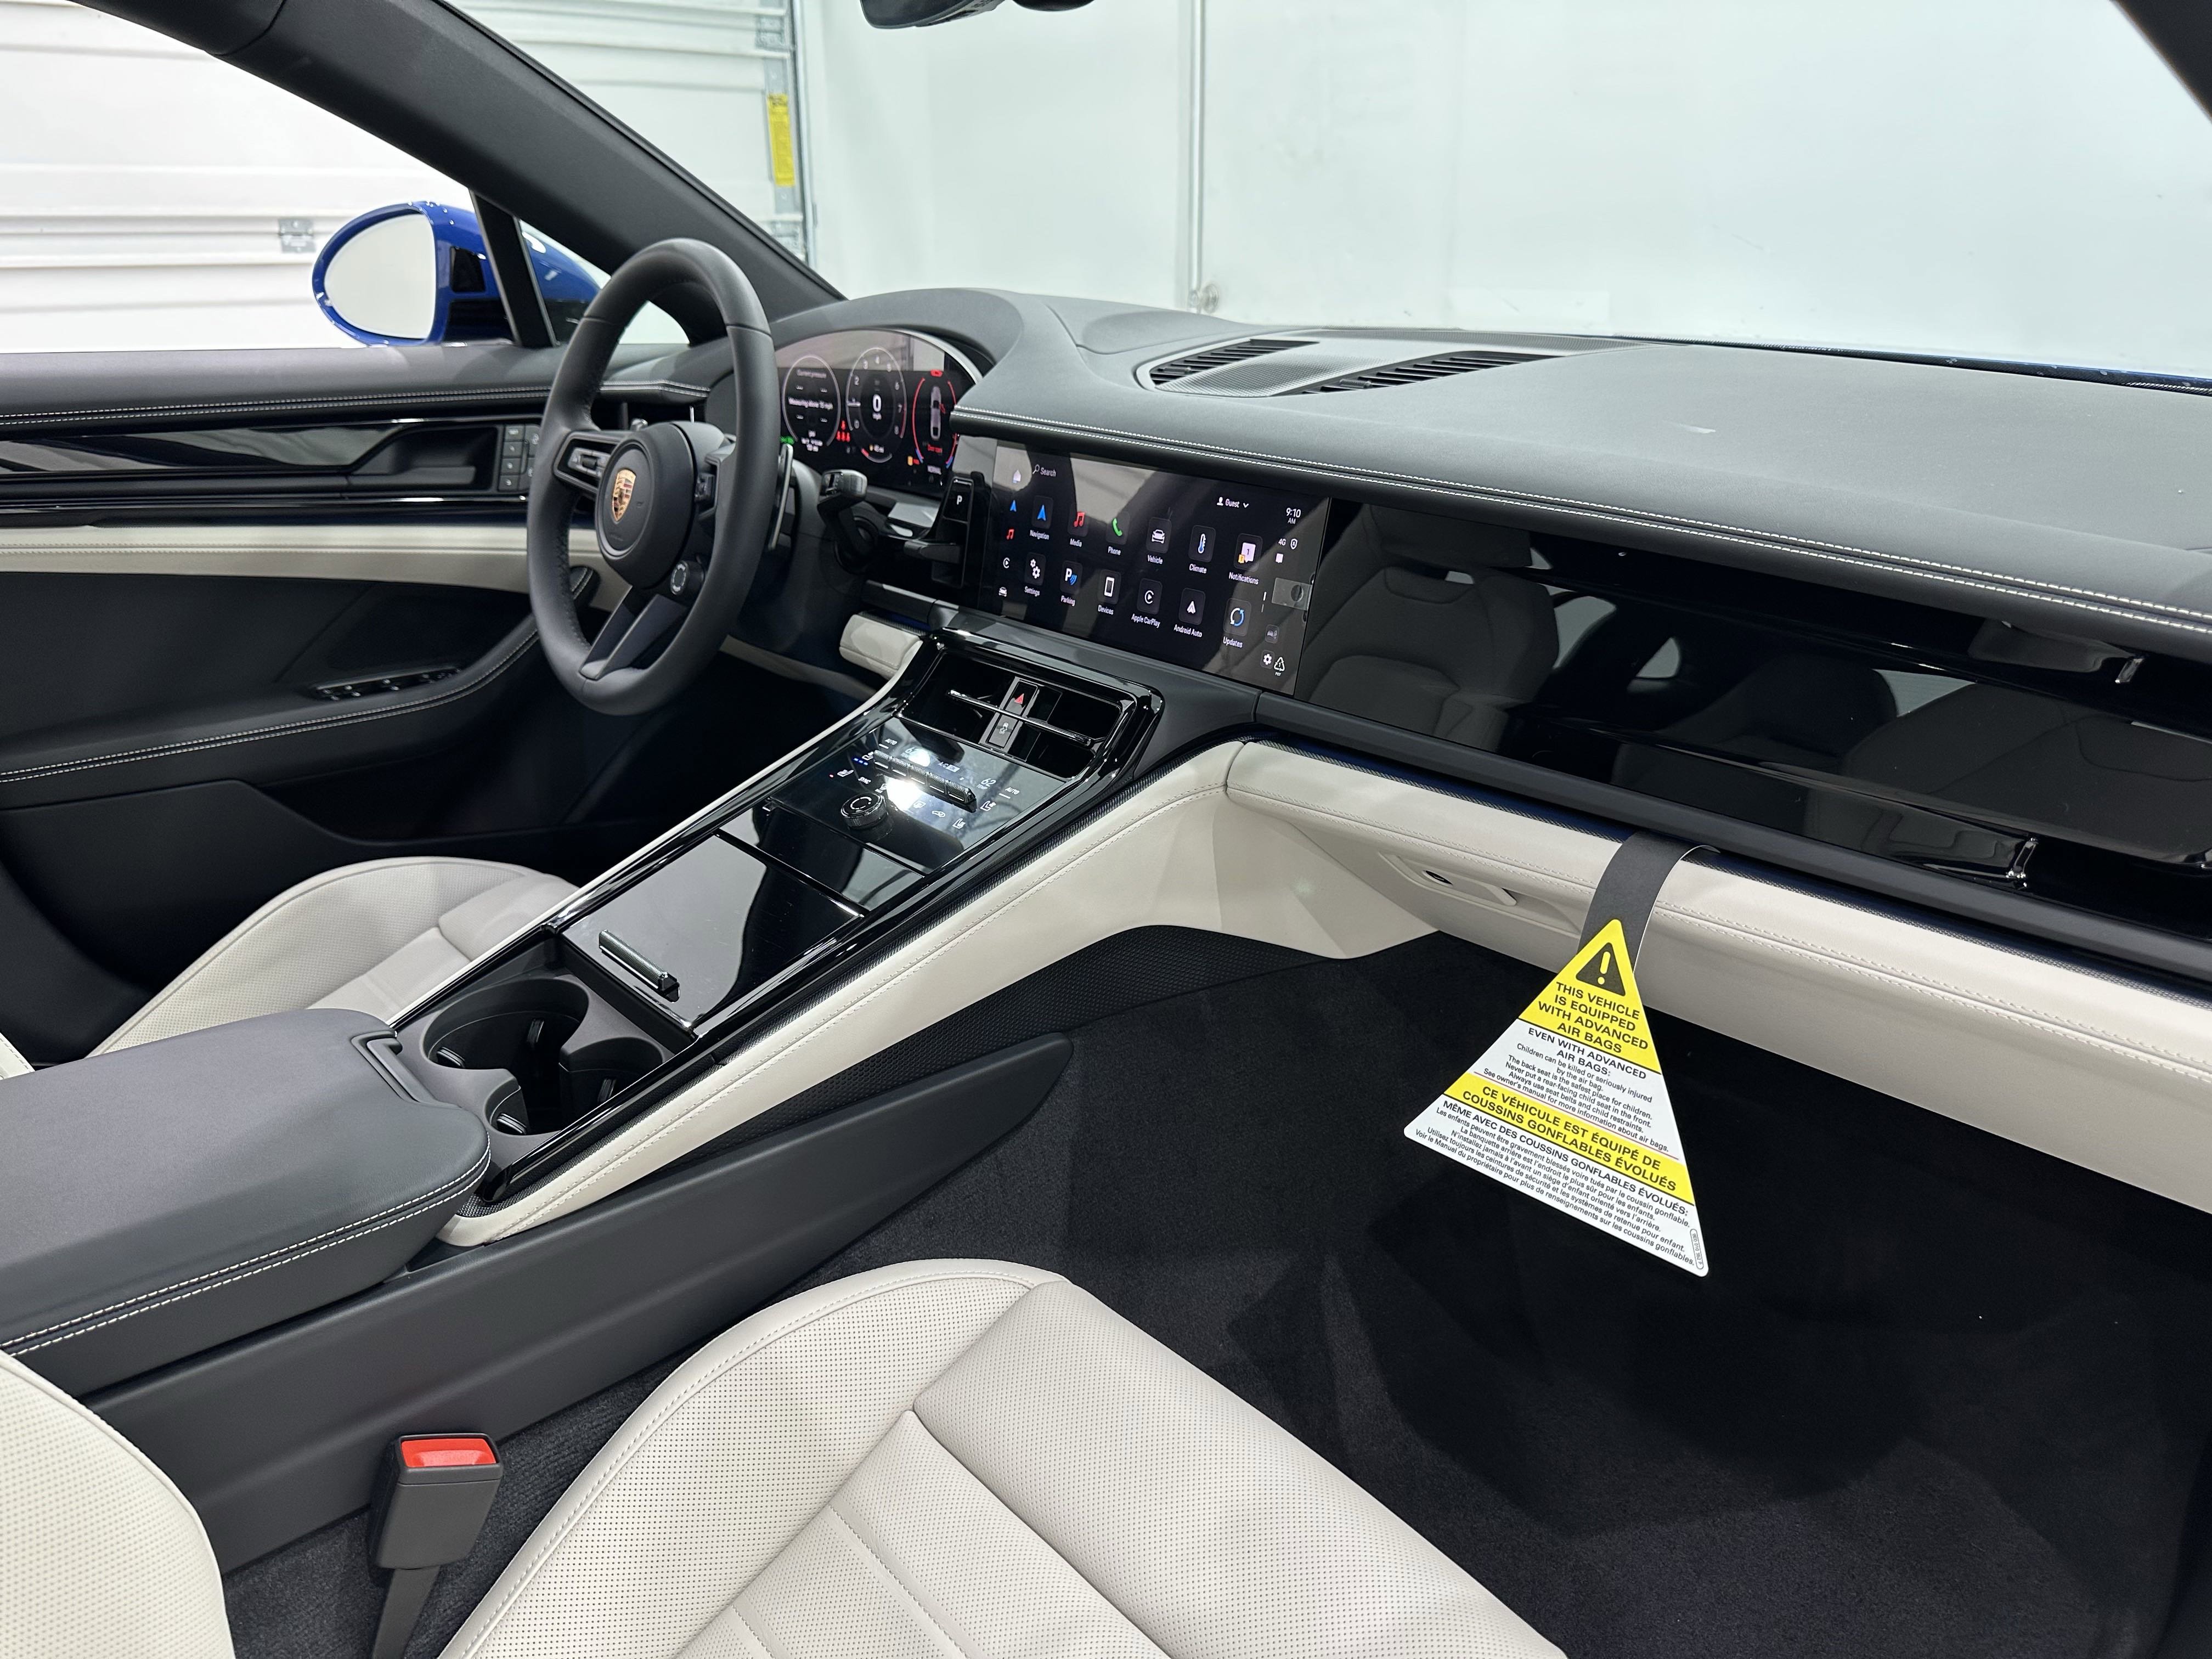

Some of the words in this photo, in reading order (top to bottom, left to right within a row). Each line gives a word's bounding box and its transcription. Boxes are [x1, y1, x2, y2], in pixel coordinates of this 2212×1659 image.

[854, 375, 859, 385] 2
[872, 394, 882, 412] 0
[1040, 467, 1056, 477] Search
[957, 495, 962, 505] P
[1225, 499, 1240, 508] Guest
[1286, 507, 1301, 518] 9:10
[1030, 529, 1049, 540] Navigation
[1070, 538, 1082, 547] Media
[1108, 546, 1121, 555] Phone
[1147, 555, 1163, 565] Vehicle
[1189, 563, 1207, 574] Climate
[1228, 572, 1259, 585] Notifications
[1024, 585, 1040, 597] Settings
[1061, 595, 1075, 607] Parking
[1098, 605, 1114, 615] Devices
[1131, 613, 1144, 623] Apple
[1144, 616, 1160, 628] CarPlay
[1173, 624, 1190, 635] Android
[1191, 629, 1202, 637] Auto
[1223, 636, 1243, 648] Updates
[981, 778, 996, 787] 62
[1005, 787, 1020, 795] AUTO
[1556, 981, 1583, 998] THIS
[1588, 992, 1639, 1019] VEHICLE
[1554, 994, 1566, 1006] IS
[1570, 1000, 1635, 1031] EQUIPPED
[1538, 1001, 1571, 1020] WITH
[1574, 1016, 1648, 1049] ADVANCED
[1557, 1022, 1580, 1037] AIR
[1584, 1031, 1621, 1053] BAGS
[1528, 1027, 1555, 1043] EVEN
[1558, 1038, 1584, 1055] WITH
[1587, 1051, 1646, 1079] ADVANCED
[1556, 1049, 1575, 1062] AIR
[1578, 1057, 1610, 1076] BAGS:
[1517, 1043, 1543, 1058] Children
[1544, 1056, 1556, 1064] can
[1558, 1059, 1566, 1068] be
[1567, 1063, 1585, 1075] killed
[1595, 1076, 1626, 1093] seriously
[1627, 1087, 1652, 1103] injured
[1556, 1067, 1565, 1076] by
[1566, 1071, 1577, 1080] the
[1589, 1080, 1602, 1091] bag.
[1505, 1061, 1525, 1074] Never
[1525, 1071, 1536, 1079] put
[1543, 1078, 1577, 1097] rear-facing
[1578, 1093, 1595, 1104] child
[1596, 1101, 1611, 1110] seat
[1612, 1105, 1618, 1114] in
[1620, 1110, 1631, 1119] the
[1633, 1115, 1651, 1127] front.
[1509, 1054, 1520, 1064] The
[1521, 1059, 1536, 1071] back
[1537, 1068, 1550, 1077] seat
[1559, 1076, 1570, 1085] the
[1571, 1082, 1591, 1094] safest
[1592, 1090, 1610, 1102] place
[1611, 1097, 1622, 1106] for
[1622, 1103, 1652, 1120] children.
[1483, 1068, 1495, 1077] See
[1522, 1086, 1546, 1099] manual
[1547, 1095, 1557, 1104] for
[1558, 1101, 1576, 1112] more
[1577, 1108, 1616, 1129] information
[1617, 1126, 1638, 1138] about
[1650, 1138, 1668, 1152] bags.
[1508, 1071, 1531, 1085] Always
[1533, 1082, 1544, 1091] use
[1545, 1087, 1559, 1097] seat
[1560, 1092, 1576, 1104] belts
[1578, 1101, 1591, 1110] and
[1592, 1107, 1609, 1118] child
[1610, 1114, 1643, 1133] restraints.
[1482, 1086, 1498, 1099] CE
[1502, 1093, 1560, 1126] VÉHICULE
[1564, 1121, 1588, 1137] EST
[1591, 1132, 1639, 1160] ÉQUIPÉ
[1642, 1155, 1660, 1170] DE
[1463, 1091, 1523, 1123] COUSSINS
[1527, 1119, 1611, 1162] GONFLABLES
[1615, 1156, 1676, 1190] ÉVOLUÉS
[1436, 1107, 1447, 1116] Les
[1447, 1114, 1470, 1127] enfants
[1470, 1124, 1496, 1139] peuvent
[1496, 1135, 1509, 1144] être
[1510, 1142, 1545, 1161] gravement
[1545, 1156, 1570, 1172] blessés
[1572, 1170, 1588, 1181] voire
[1590, 1177, 1604, 1188] tués
[1605, 1185, 1617, 1194] par
[1618, 1189, 1625, 1198] le
[1626, 1195, 1653, 1210] coussin
[1654, 1207, 1689, 1227] gonflable.
[1443, 1100, 1471, 1118] MÊME
[1472, 1114, 1497, 1129] AVEC
[1498, 1125, 1517, 1138] DES
[1519, 1135, 1568, 1161] COUSSINS
[1571, 1158, 1636, 1192] GONFLABLES
[1638, 1187, 1688, 1216] ÉVOLUÉS:
[1460, 1126, 1468, 1134] La
[1469, 1130, 1499, 1149] banquette
[1500, 1146, 1521, 1159] arrière
[1522, 1156, 1533, 1164] est
[1569, 1177, 1584, 1187] plus
[1598, 1190, 1615, 1201] pour
[1615, 1197, 1626, 1206] les
[1627, 1204, 1655, 1220] enfants.
[1482, 1144, 1503, 1159] jamais
[1542, 1173, 1560, 1185] siège
[1590, 1195, 1614, 1210] orienté
[1616, 1207, 1630, 1217] vers
[1416, 1128, 1427, 1139] Voir
[1434, 1138, 1457, 1153] Manuel
[1466, 1154, 1503, 1175] propriétaire
[1503, 1172, 1519, 1182] pour
[1520, 1180, 1534, 1190] plus
[1545, 1192, 1598, 1220] renseignements
[1599, 1217, 1611, 1225] sur
[1612, 1221, 1622, 1231] les
[1623, 1228, 1654, 1246] coussins
[1655, 1243, 1695, 1265] gonflables.
